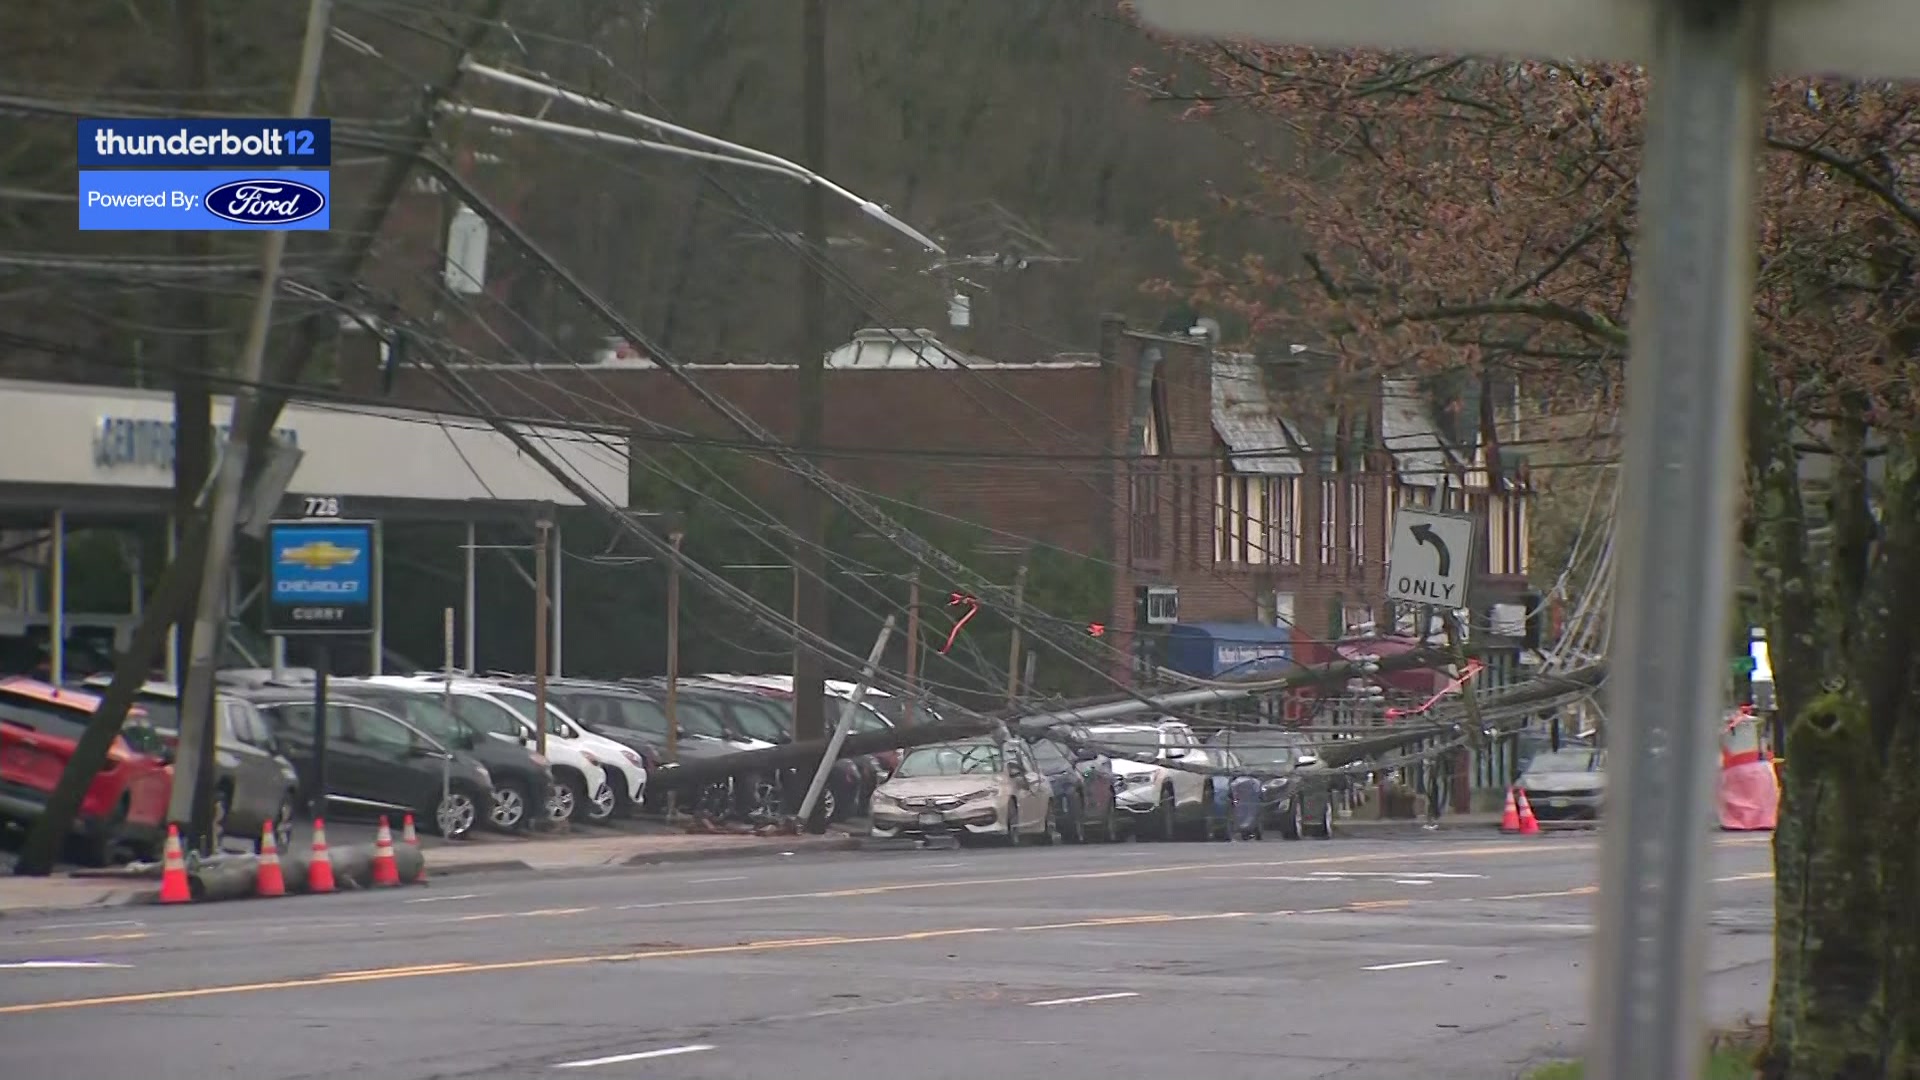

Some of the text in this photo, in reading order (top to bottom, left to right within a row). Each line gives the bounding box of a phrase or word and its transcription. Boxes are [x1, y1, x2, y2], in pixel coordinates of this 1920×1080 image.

[303, 497, 339, 516] 728
[277, 581, 358, 593] CHEVROLET
[1398, 577, 1456, 600] ONLY
[292, 607, 345, 620] CURRY
